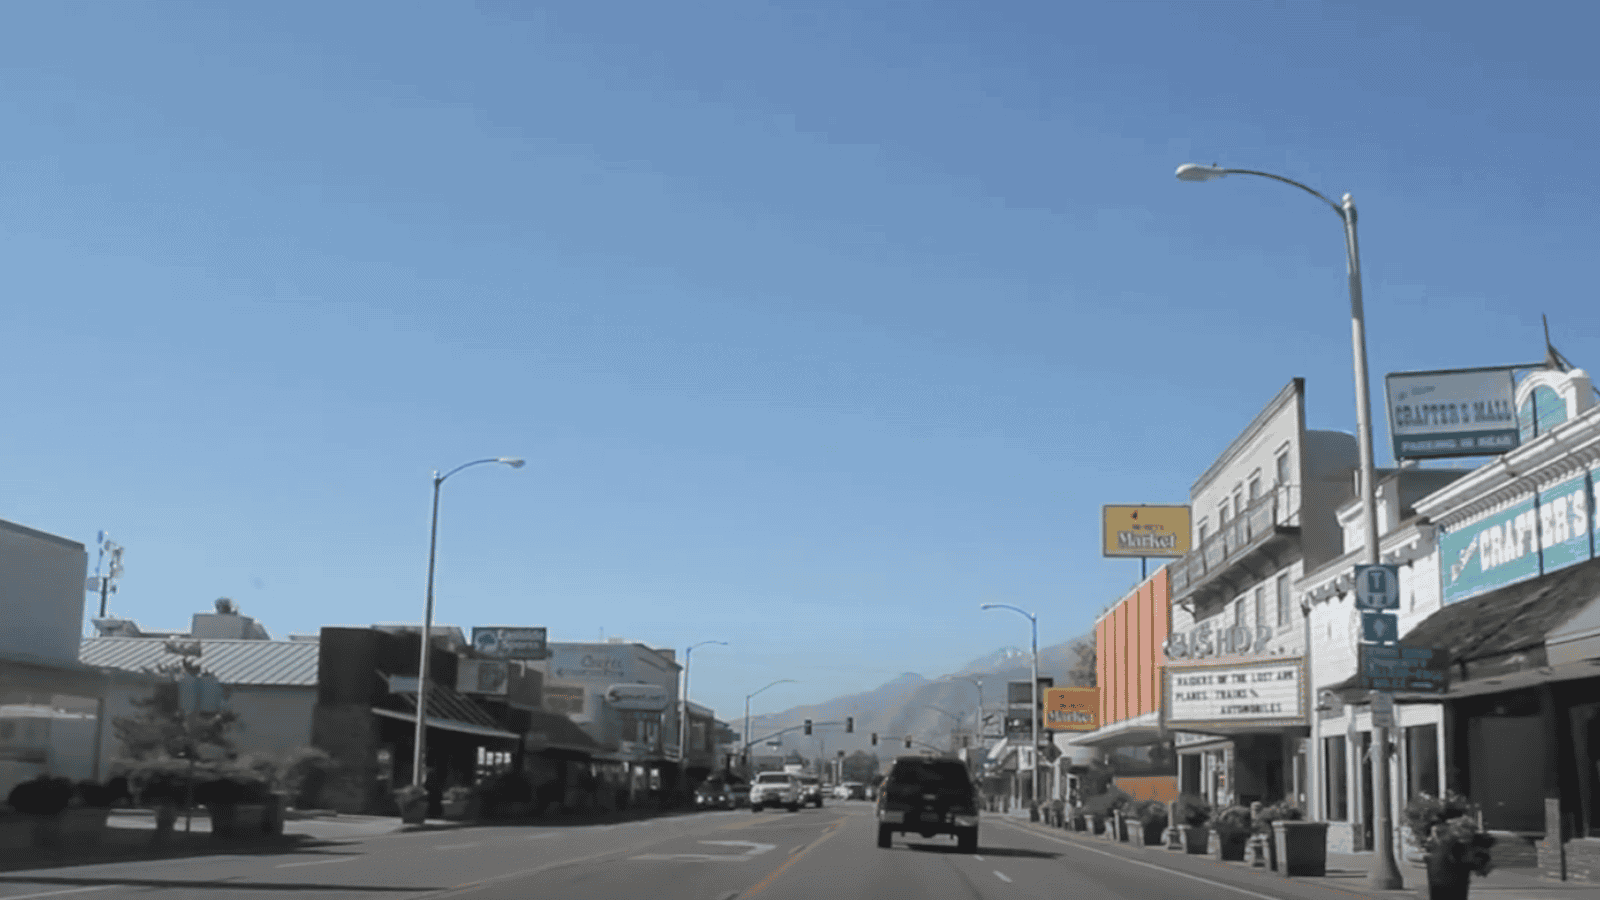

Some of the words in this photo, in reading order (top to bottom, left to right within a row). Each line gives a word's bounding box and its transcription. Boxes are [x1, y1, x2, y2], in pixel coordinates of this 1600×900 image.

[1474, 400, 1512, 422] MALL
[1480, 489, 1587, 572] CRAFTER'S
[1118, 530, 1176, 549] Market
[1165, 620, 1273, 660] BISHOP
[1231, 673, 1247, 684] THE
[1252, 672, 1273, 683] LOST
[1215, 689, 1247, 700] TRAINS
[1221, 702, 1282, 715] AUTOMOBILES
[1047, 710, 1094, 724] Market
